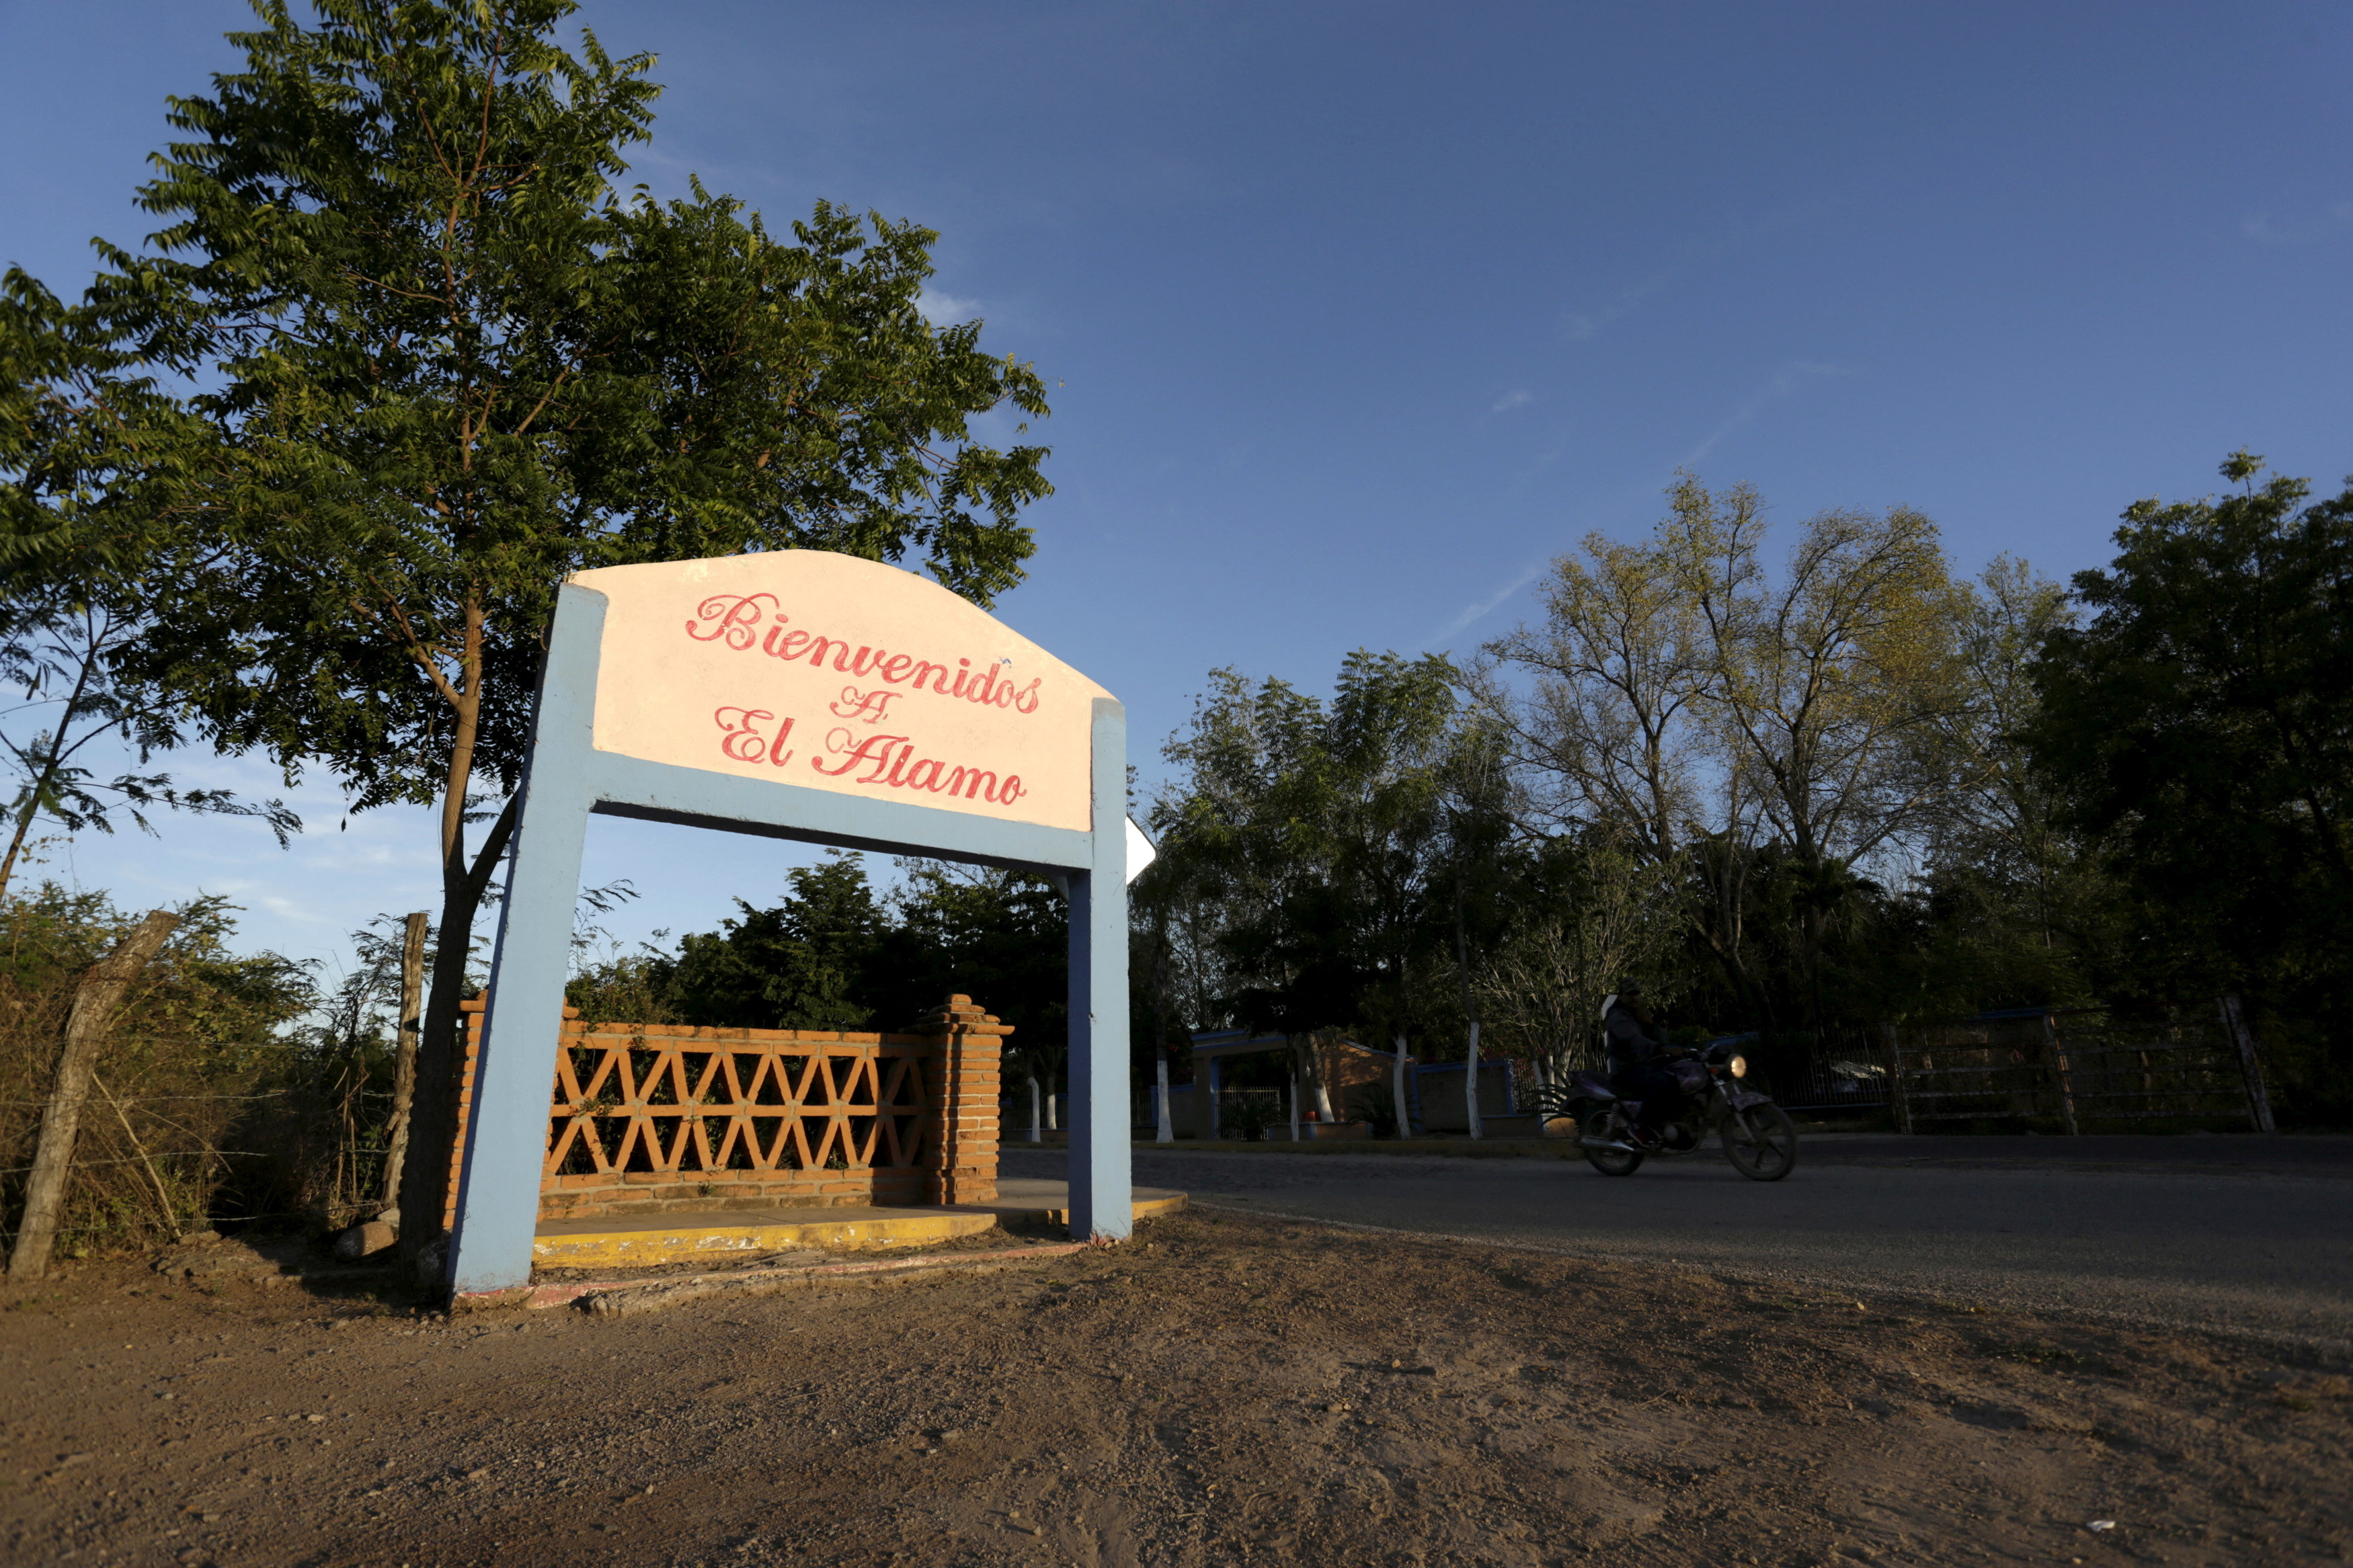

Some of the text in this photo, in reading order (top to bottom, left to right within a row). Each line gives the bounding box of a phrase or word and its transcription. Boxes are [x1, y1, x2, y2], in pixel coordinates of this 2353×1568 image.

[685, 592, 1041, 714] Bienvenidos
[830, 686, 903, 724] A
[714, 706, 1027, 806] El Alamo
